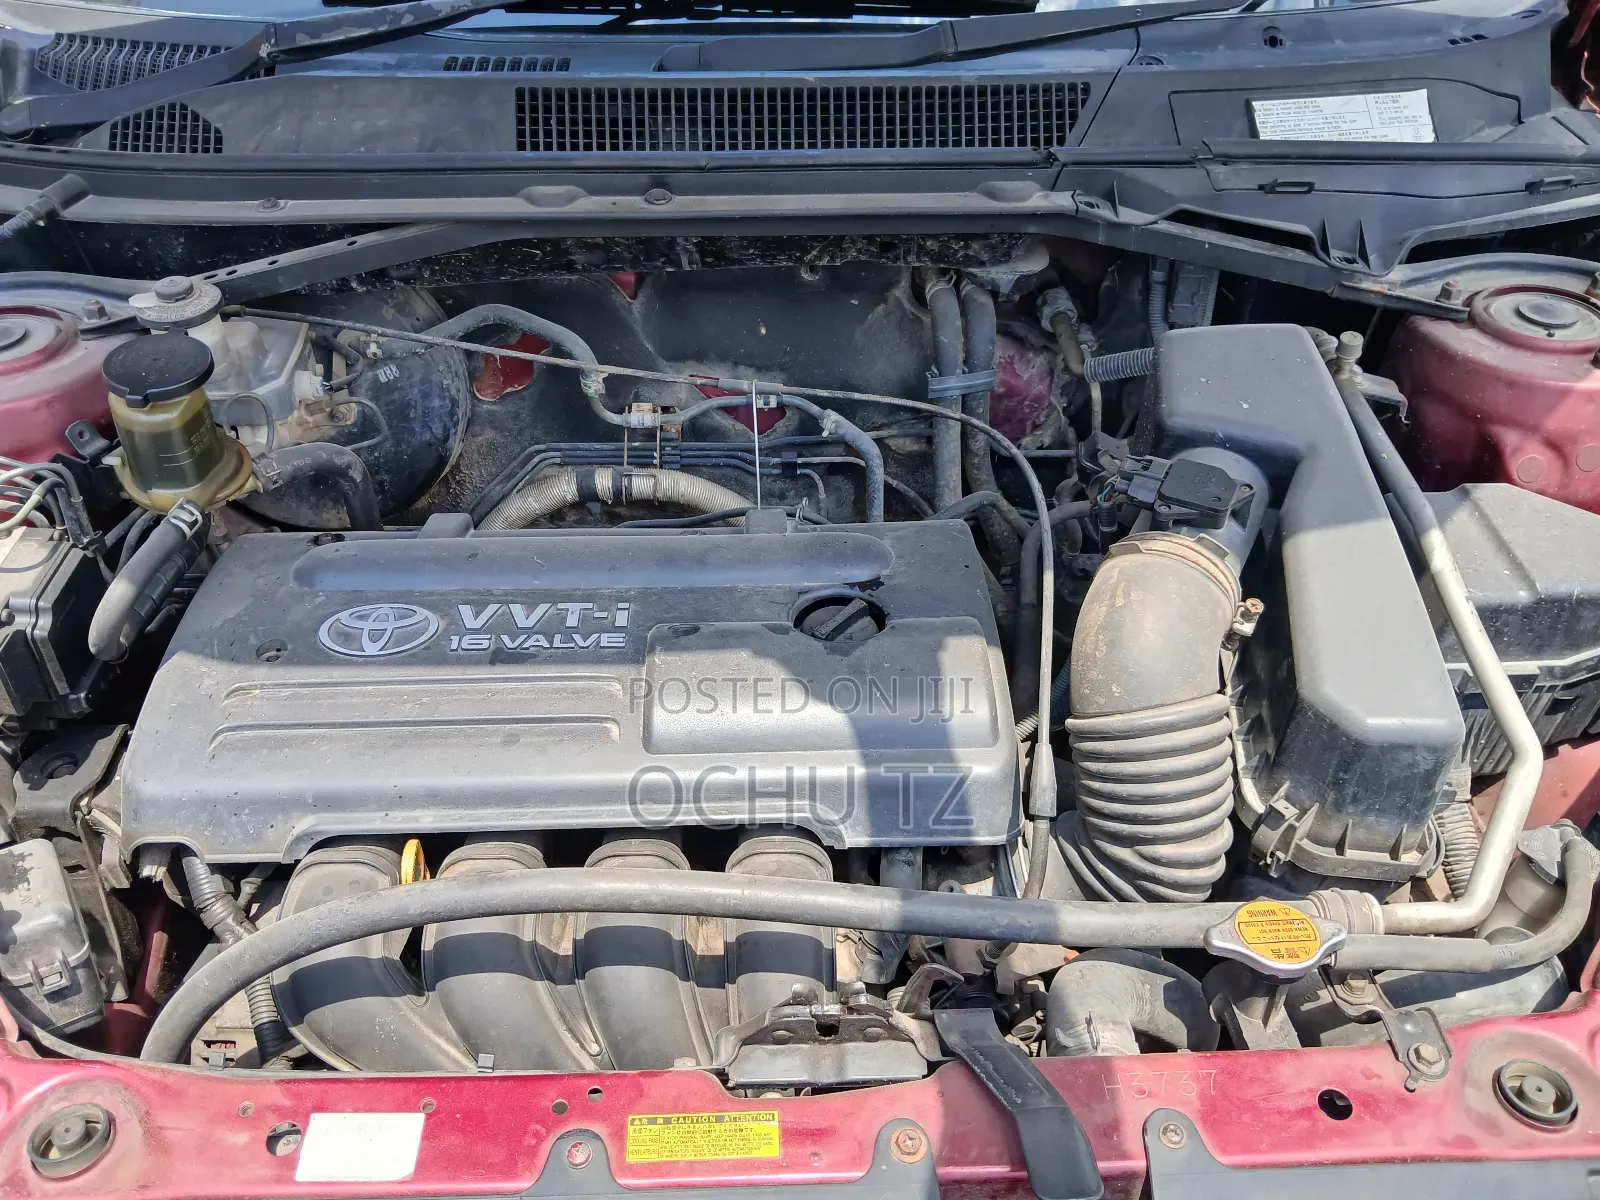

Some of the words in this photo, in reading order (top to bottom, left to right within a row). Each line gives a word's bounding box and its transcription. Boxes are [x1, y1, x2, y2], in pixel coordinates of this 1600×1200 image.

[457, 602, 631, 631] VVT-i
[450, 634, 493, 651] 16
[499, 632, 627, 650] VALVE
[1246, 908, 1279, 918] WARNING
[1270, 947, 1300, 959] 警告
[1101, 1069, 1217, 1100] H3737
[671, 1115, 716, 1124] CAUTION
[723, 1113, 773, 1122] ATTENTION
